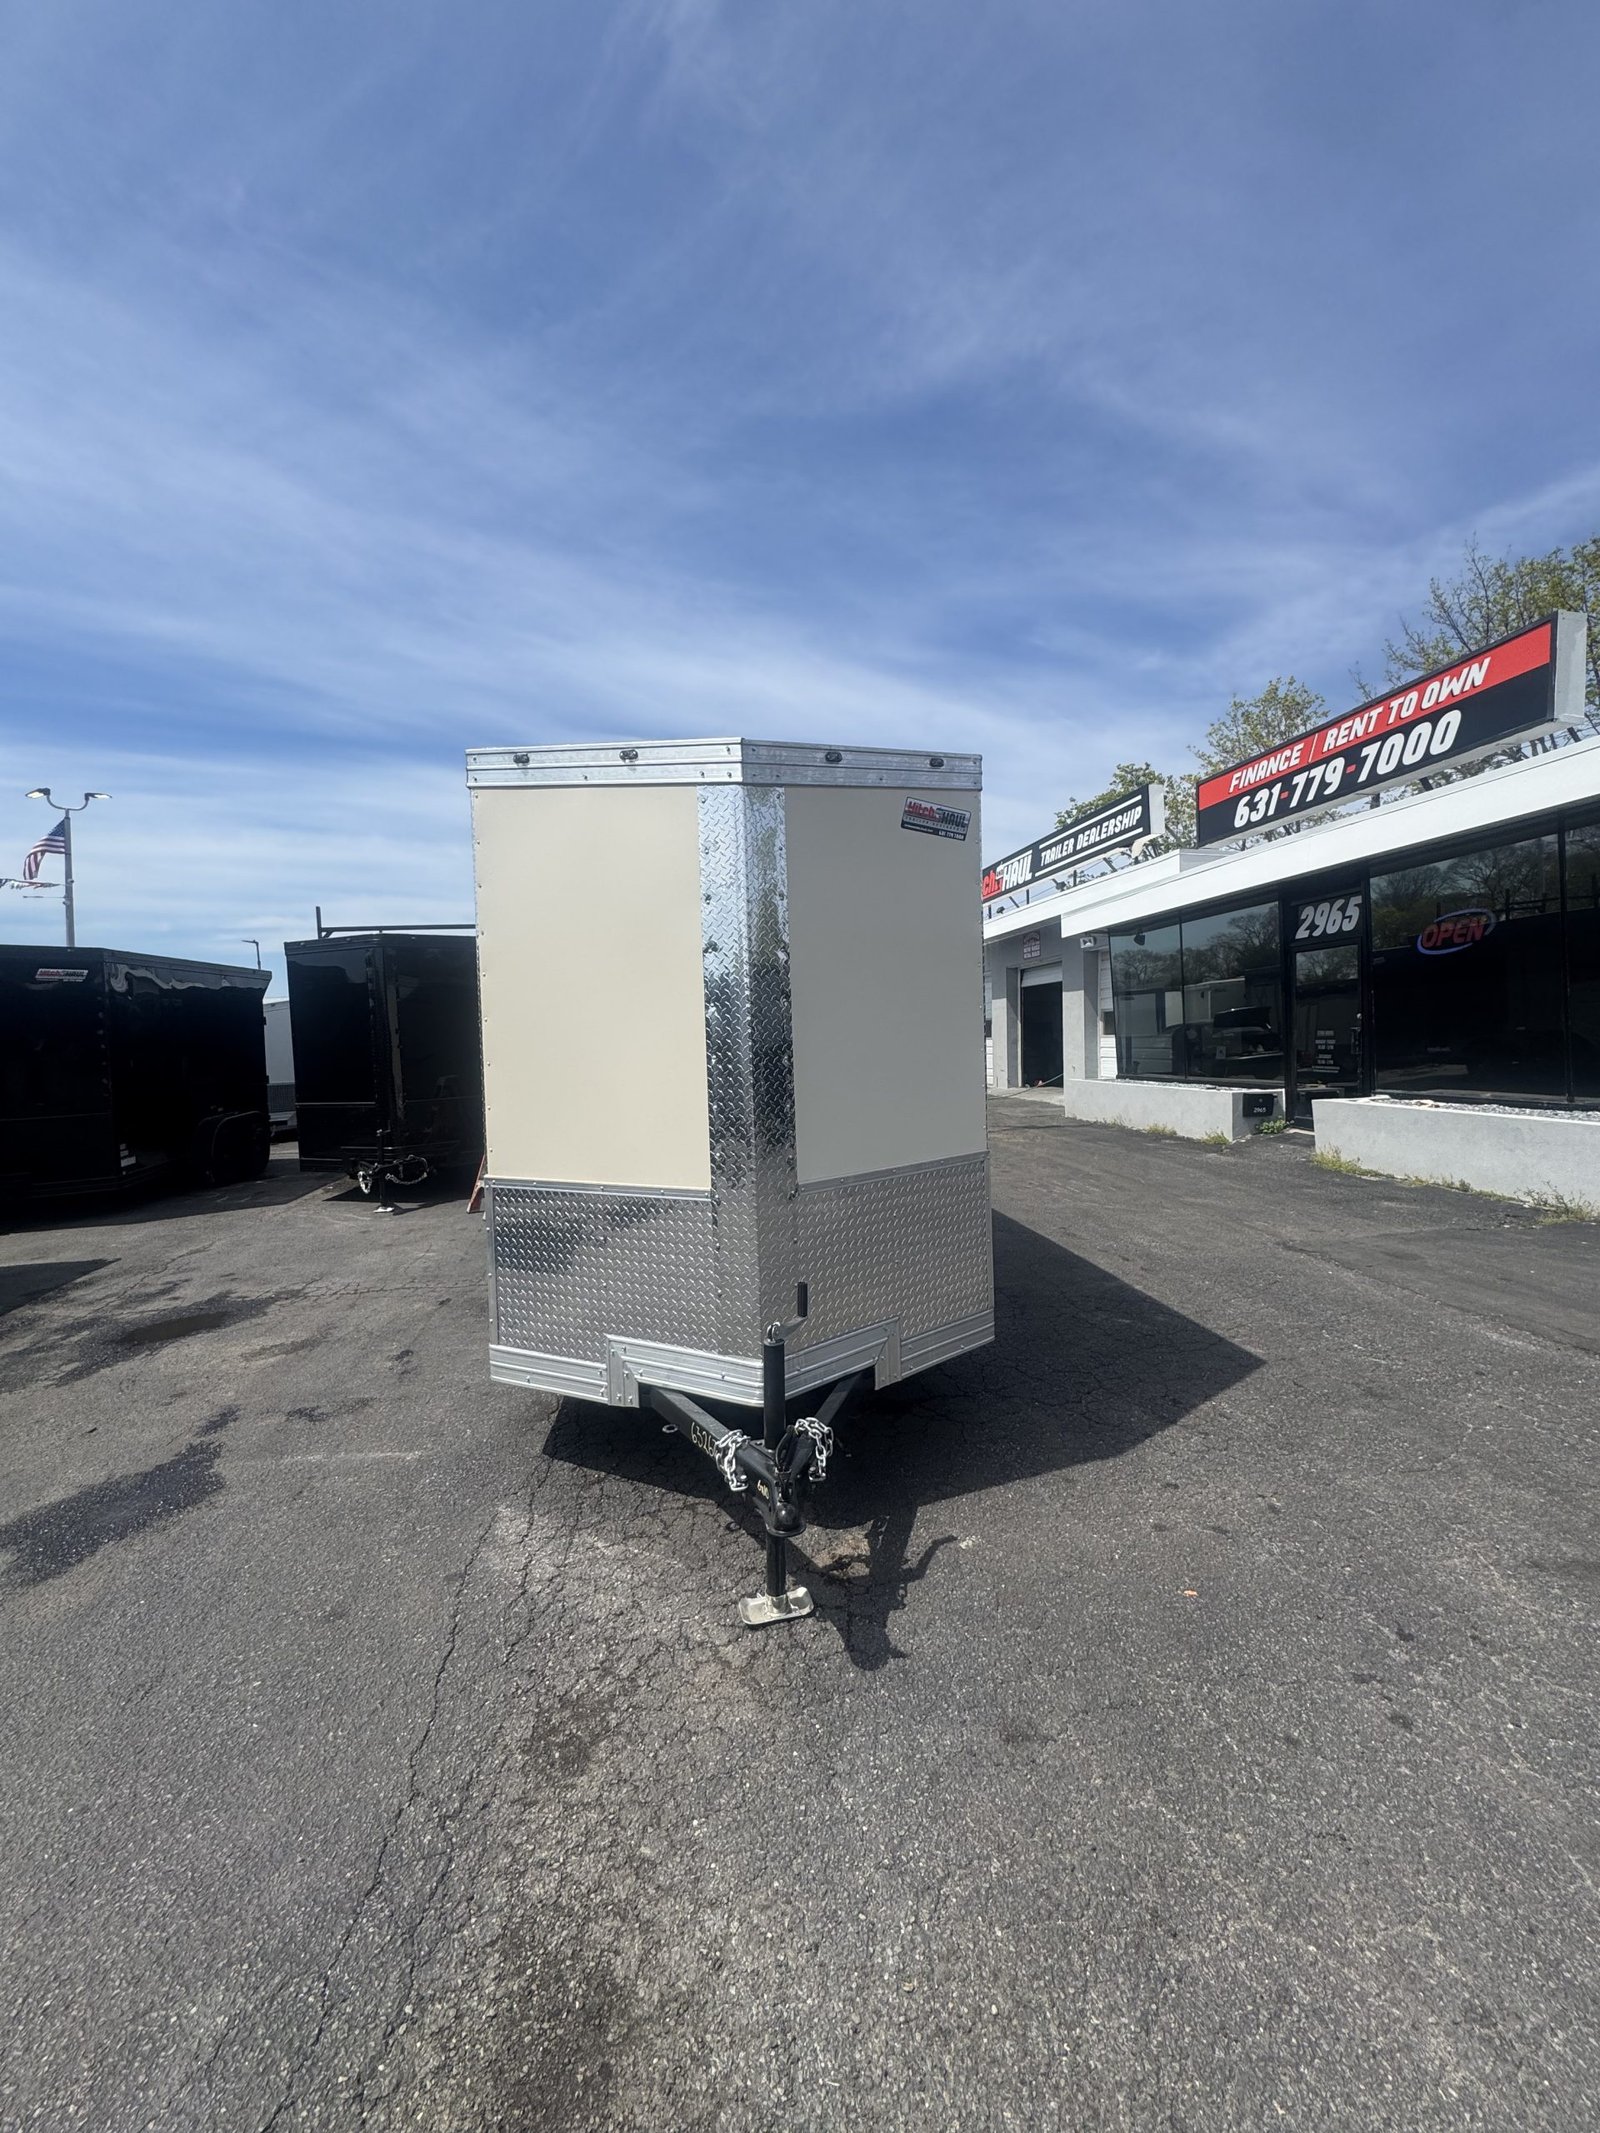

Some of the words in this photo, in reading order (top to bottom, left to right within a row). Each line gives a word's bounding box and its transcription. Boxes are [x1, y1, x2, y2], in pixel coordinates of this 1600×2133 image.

[1322, 707, 1383, 754] RENT
[1387, 690, 1419, 725] TO
[1421, 657, 1491, 710] OWN
[1228, 742, 1304, 793] FINANCE
[1233, 709, 1463, 829] 631-779-7000
[1041, 837, 1074, 867] TRAILER
[1076, 806, 1143, 851] DEALERSHIP
[1002, 854, 1032, 892] HAUL
[1295, 895, 1362, 940] 2965
[1421, 915, 1488, 949] OPEN
